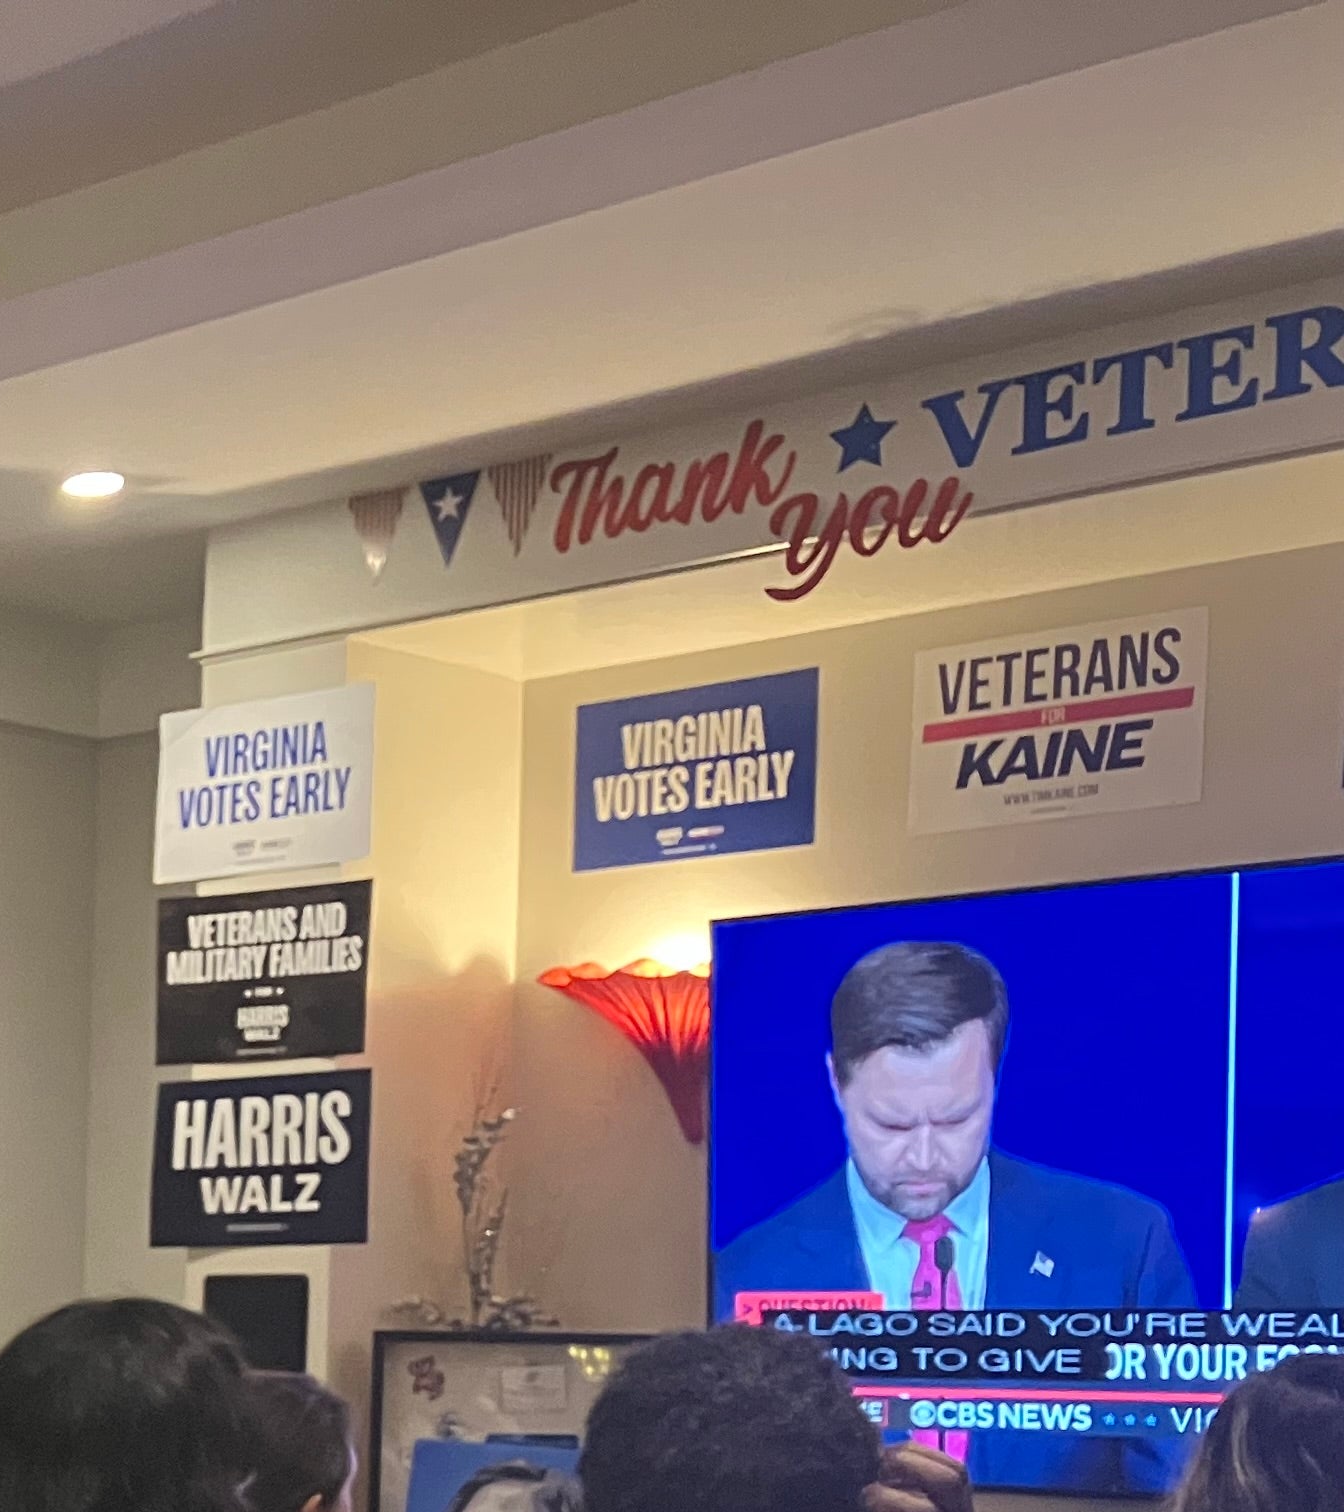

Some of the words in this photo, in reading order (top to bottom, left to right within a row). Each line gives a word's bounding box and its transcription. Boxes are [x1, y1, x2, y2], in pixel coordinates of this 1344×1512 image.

[551, 419, 796, 553] Thank
[939, 627, 1181, 715] VETERANS
[621, 705, 766, 770] VIRGINIA
[1041, 706, 1066, 724] FOR
[205, 721, 328, 778] VIRGINIA
[955, 718, 1153, 789] KAINE
[179, 780, 262, 829] VOTES
[270, 767, 351, 819] EARLY
[593, 765, 689, 822] VOTES
[695, 750, 794, 810] EARLY
[187, 906, 298, 949] VETERANS
[299, 901, 347, 940] AND
[166, 945, 267, 986] MILITARY
[269, 935, 363, 978] FAMILIES
[173, 1090, 352, 1170] HARRIS
[200, 1172, 321, 1215] WALZ
[928, 1312, 1026, 1337] SAID
[1039, 1312, 1206, 1338] YOU'RE
[913, 1347, 968, 1372] TO
[978, 1348, 1082, 1374] GIVE
[1152, 1343, 1247, 1381] YOUR
[936, 1401, 995, 1429] CBS
[997, 1401, 1092, 1431] NEWS
